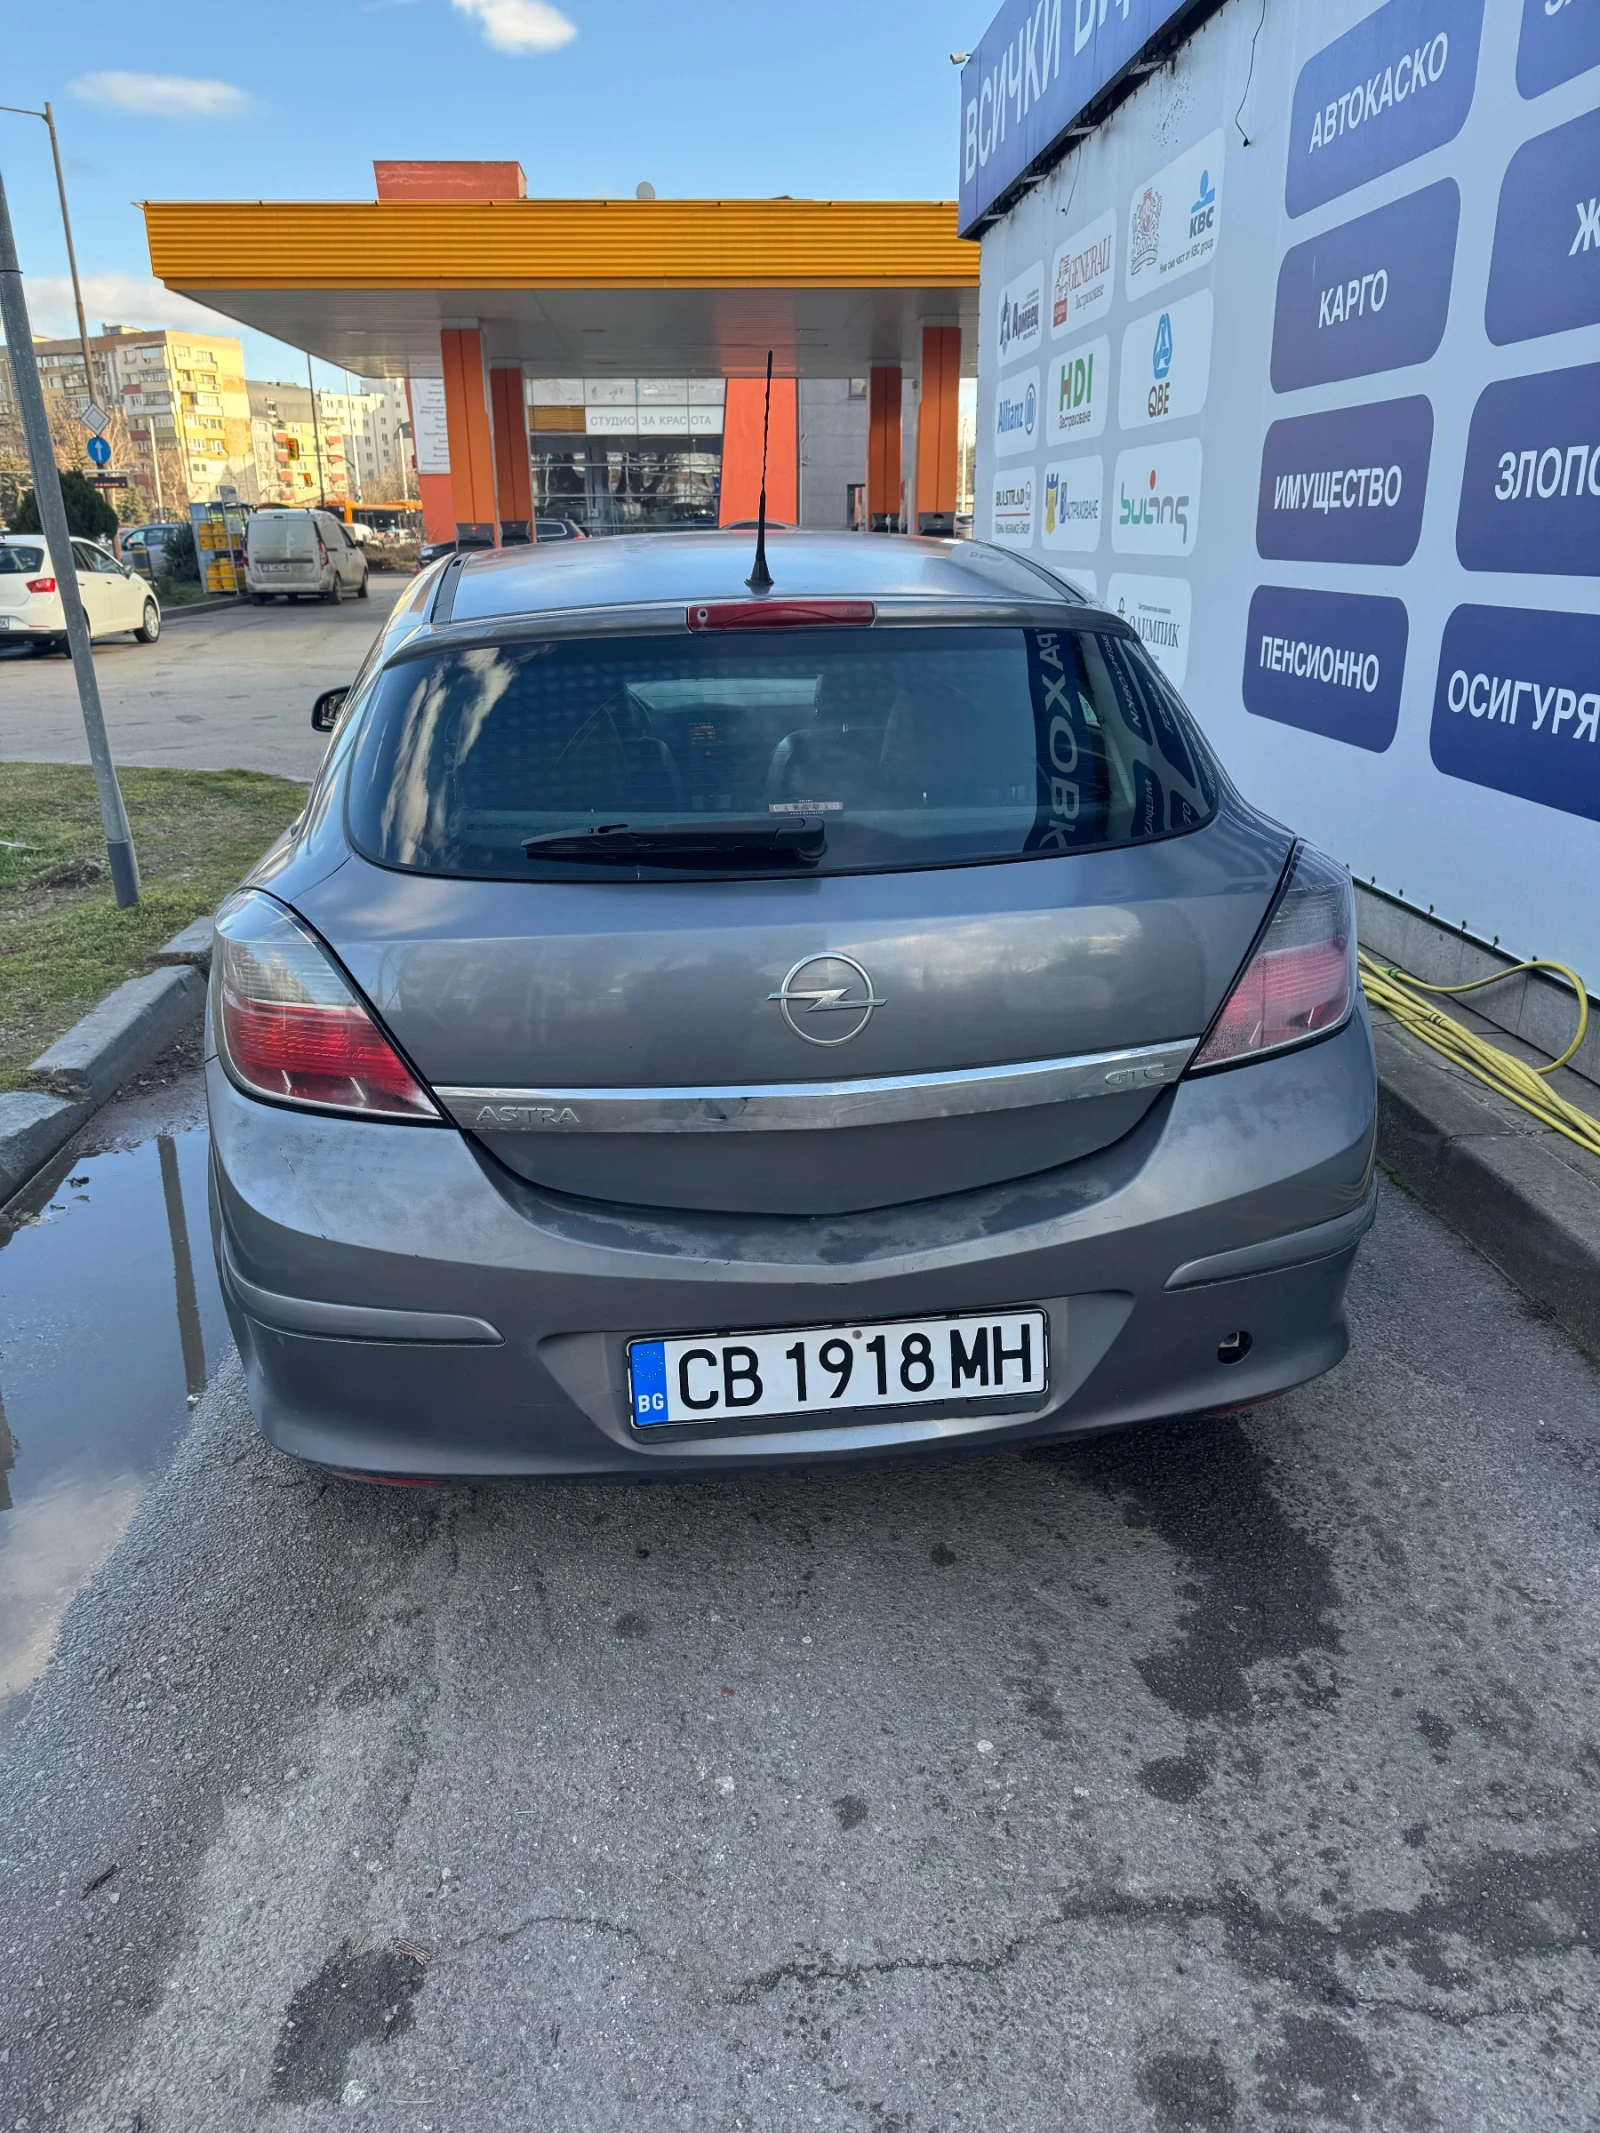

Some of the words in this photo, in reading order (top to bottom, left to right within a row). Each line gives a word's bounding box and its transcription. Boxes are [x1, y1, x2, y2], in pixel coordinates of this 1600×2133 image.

[965, 0, 1061, 185] ВСИЧКИ
[1308, 32, 1448, 154] АВТОКАСКО
[1189, 206, 1214, 239] KBC
[1069, 235, 1111, 291] GENERALI
[1318, 268, 1388, 328] КАРГО
[1059, 353, 1093, 412] HDI
[1148, 382, 1170, 418] QBE
[590, 415, 636, 427] СТУДИО
[641, 415, 656, 426] ЗА
[659, 415, 712, 426] КРАСОТА
[997, 399, 1024, 434] Allianz
[1274, 465, 1403, 515] ИМУЩЕСТВО
[1260, 635, 1380, 692] ПЕНСИОННО
[1448, 669, 1600, 743] ОСИГУРЯ
[1105, 1063, 1164, 1086] GTC
[476, 1106, 580, 1123] ASTRA
[678, 1345, 764, 1410] CB
[786, 1332, 935, 1402] 1918
[949, 1323, 1032, 1389] MH
[637, 1392, 666, 1413] BG
